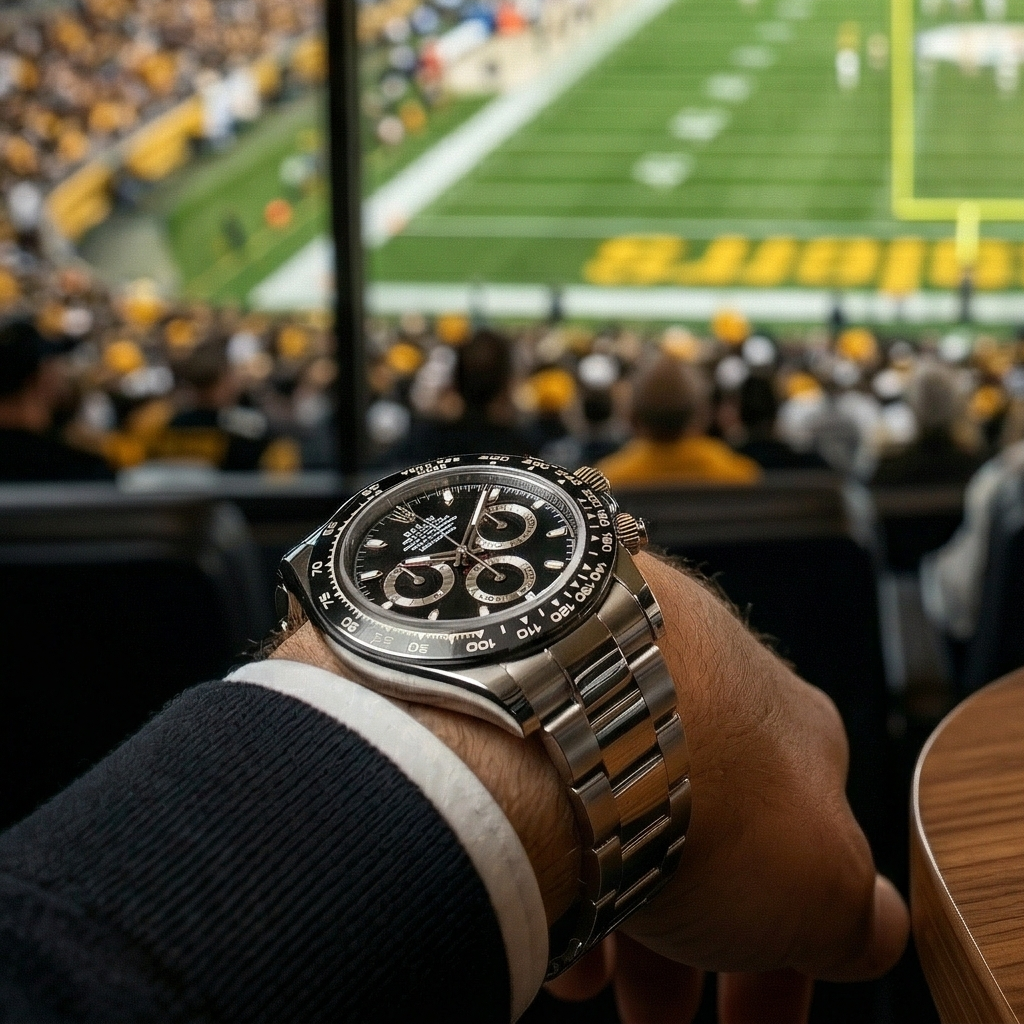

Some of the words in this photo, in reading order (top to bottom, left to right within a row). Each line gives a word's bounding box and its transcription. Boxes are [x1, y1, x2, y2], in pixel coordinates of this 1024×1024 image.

[311, 561, 323, 577] 70
[516, 623, 542, 640] 110
[466, 638, 497, 653] 100
